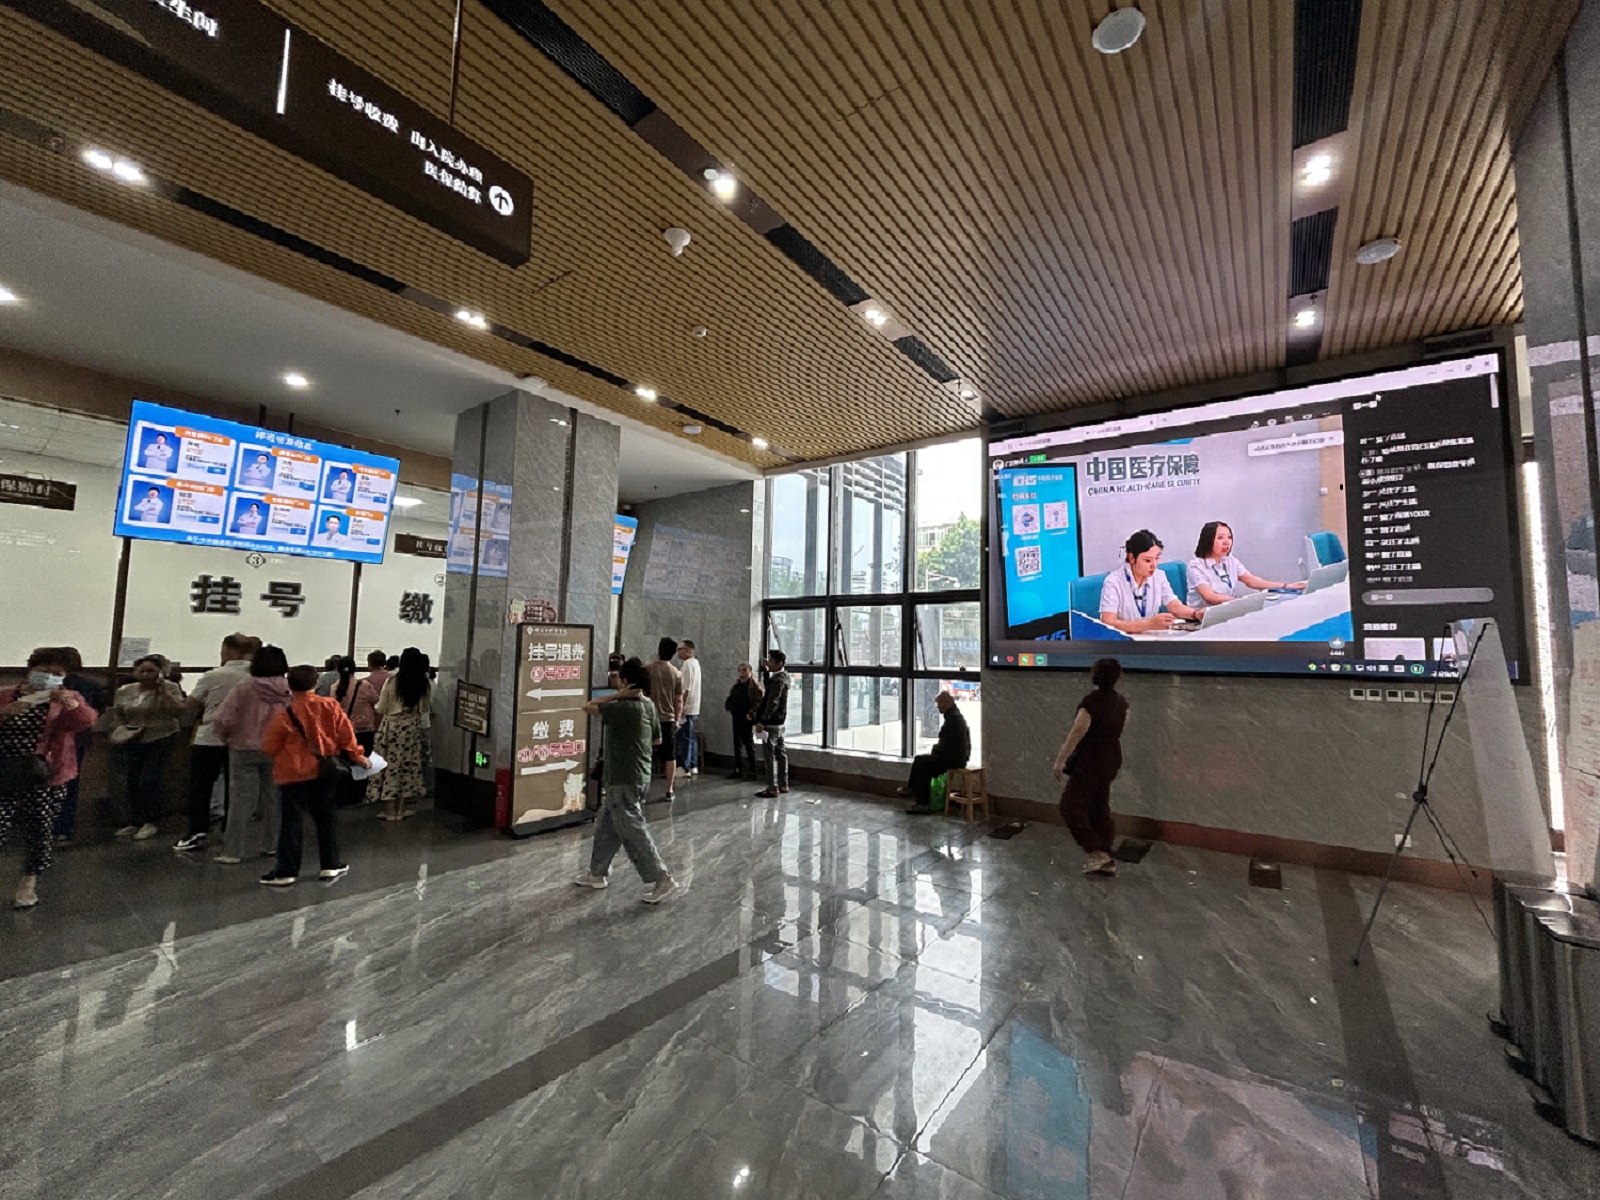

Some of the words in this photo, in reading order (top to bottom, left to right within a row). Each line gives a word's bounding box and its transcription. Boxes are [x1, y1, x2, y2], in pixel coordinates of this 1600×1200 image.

[1086, 453, 1200, 482] 中国医疗保障
[1087, 485, 1116, 497] CHINA
[398, 590, 434, 625] 缴
[527, 642, 586, 662] 挂号退费
[532, 719, 575, 740] 缴费
